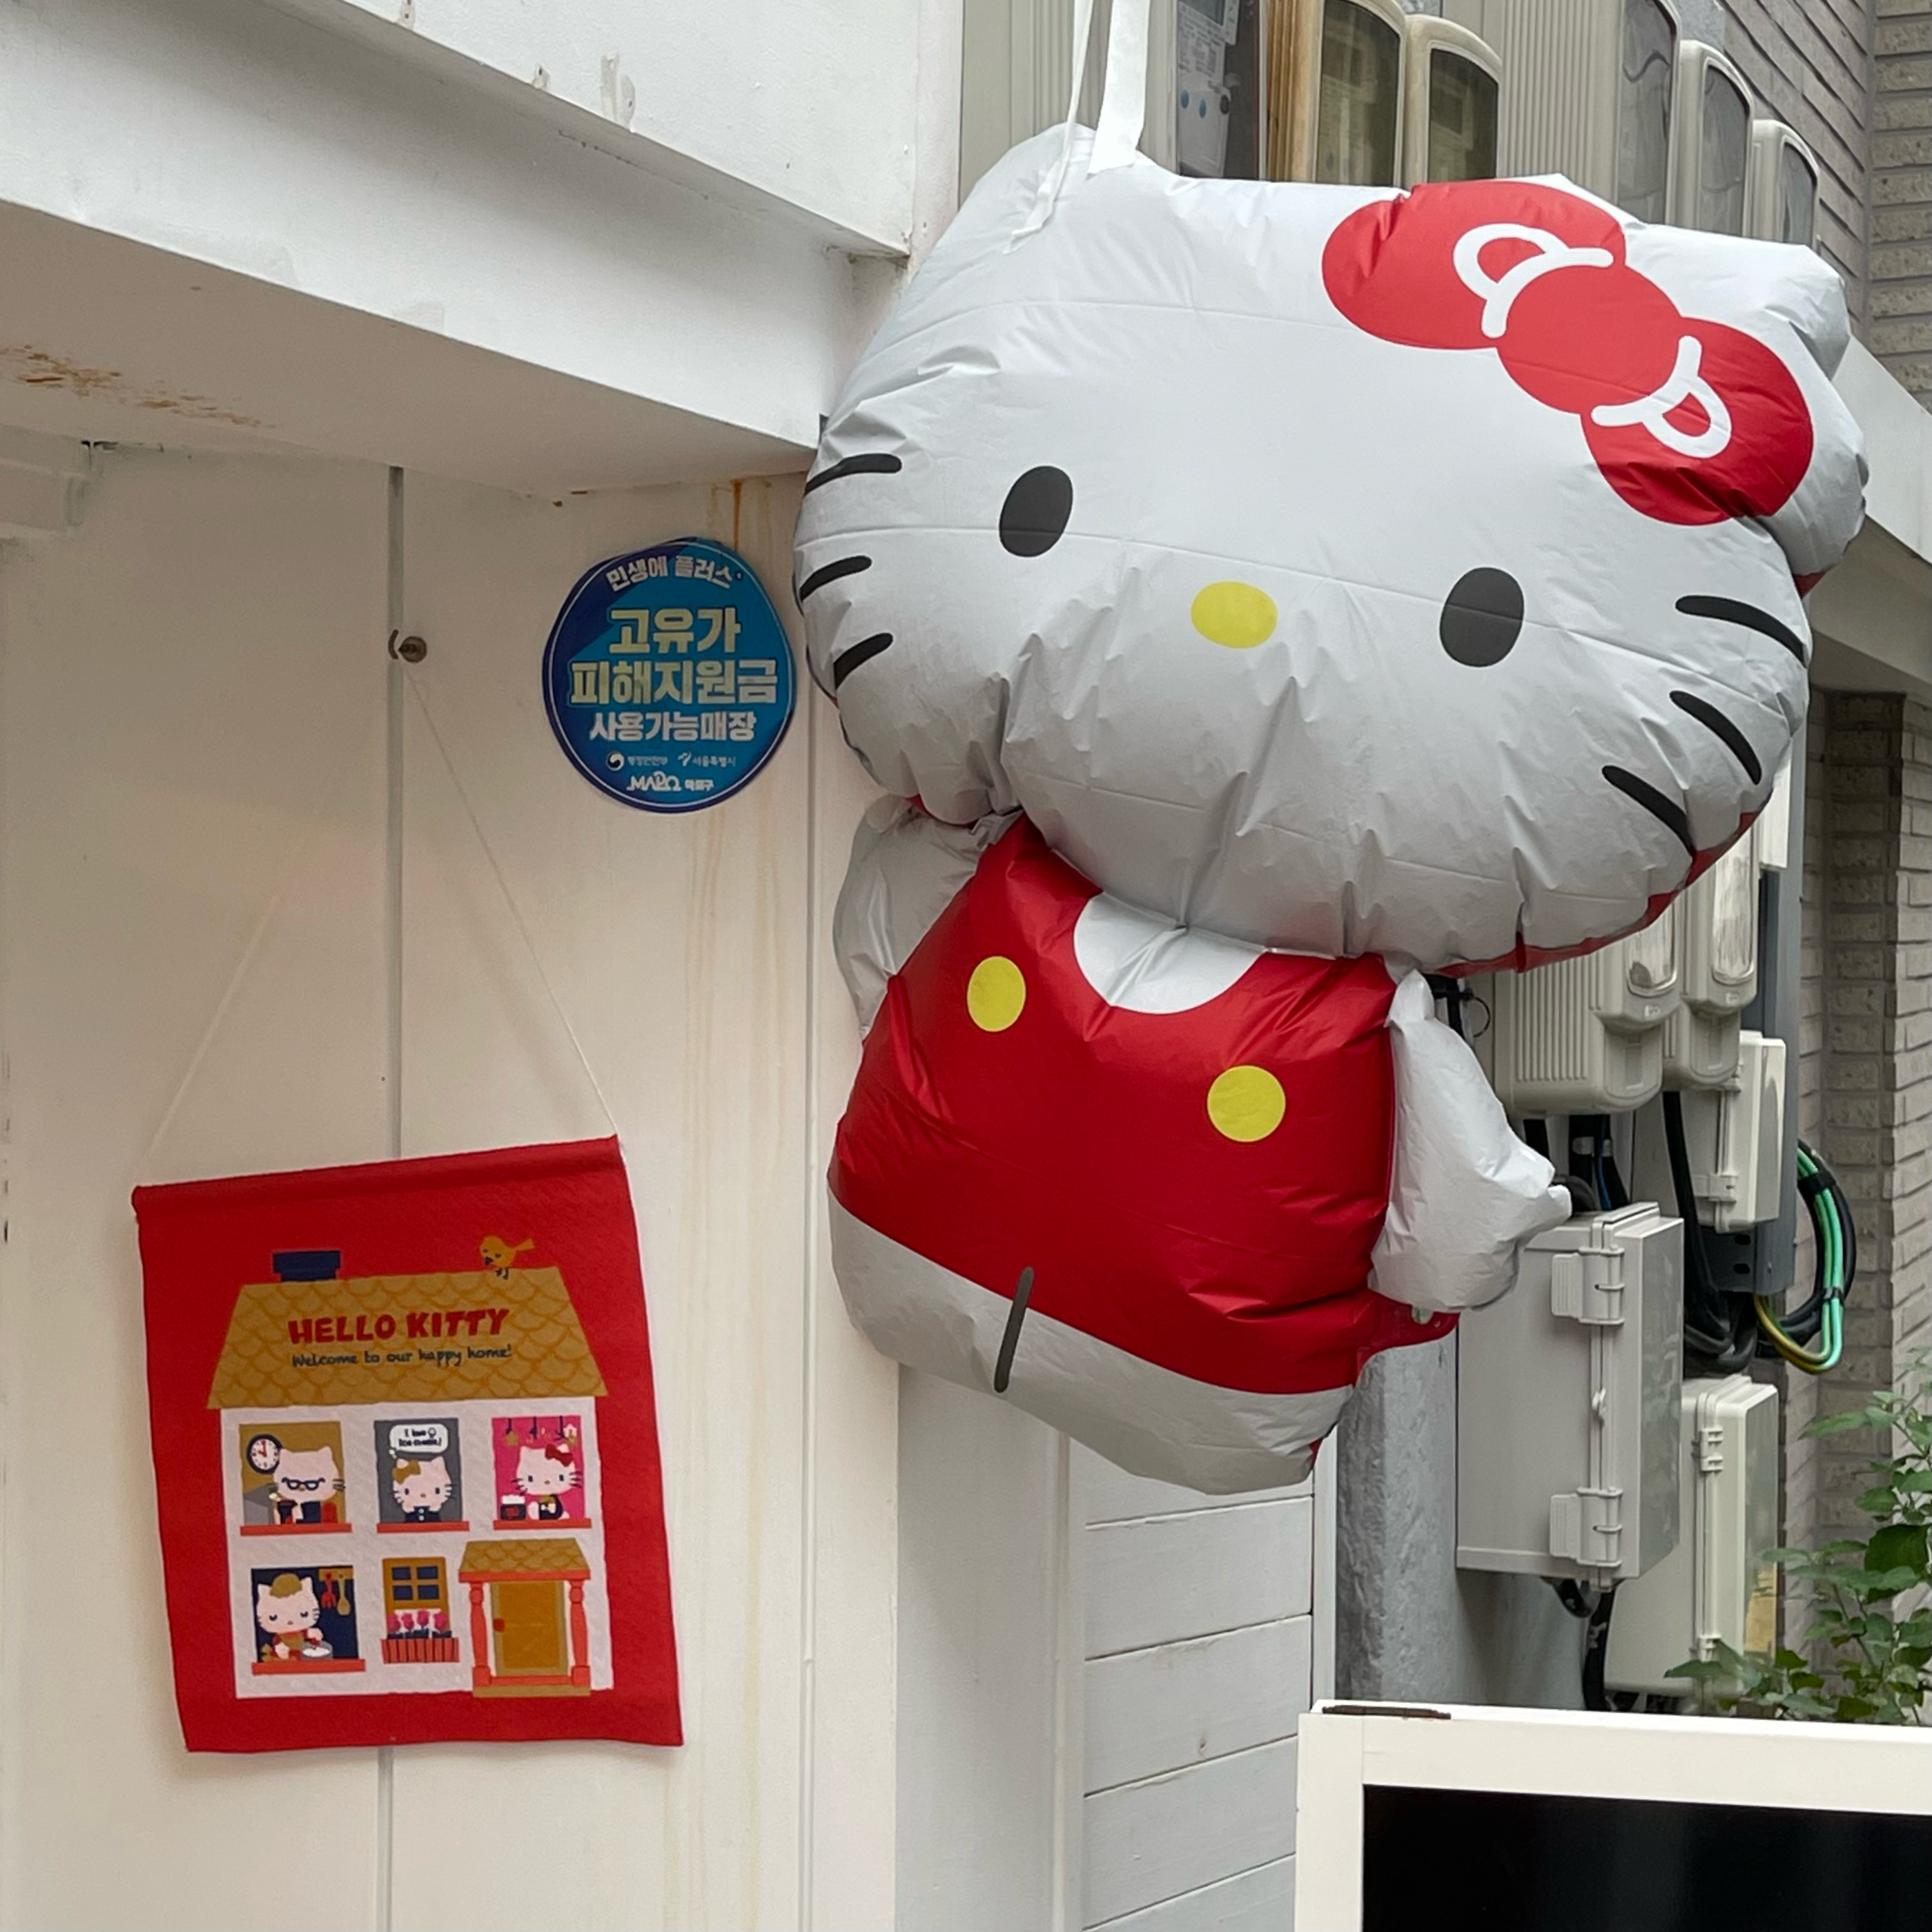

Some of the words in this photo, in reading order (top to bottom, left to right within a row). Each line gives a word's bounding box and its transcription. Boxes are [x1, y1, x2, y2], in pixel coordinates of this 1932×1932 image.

[606, 556, 668, 592] 민생에
[675, 555, 732, 589] 플러스
[609, 607, 741, 654] 고유가
[571, 659, 778, 704] 피해지원금
[589, 711, 757, 741] 사용가능매장
[288, 1314, 396, 1344] HELLO
[407, 1308, 509, 1338] KITTY
[292, 1353, 358, 1367] Welcome
[364, 1351, 380, 1363] to
[387, 1352, 412, 1362] our
[418, 1348, 462, 1367] happy
